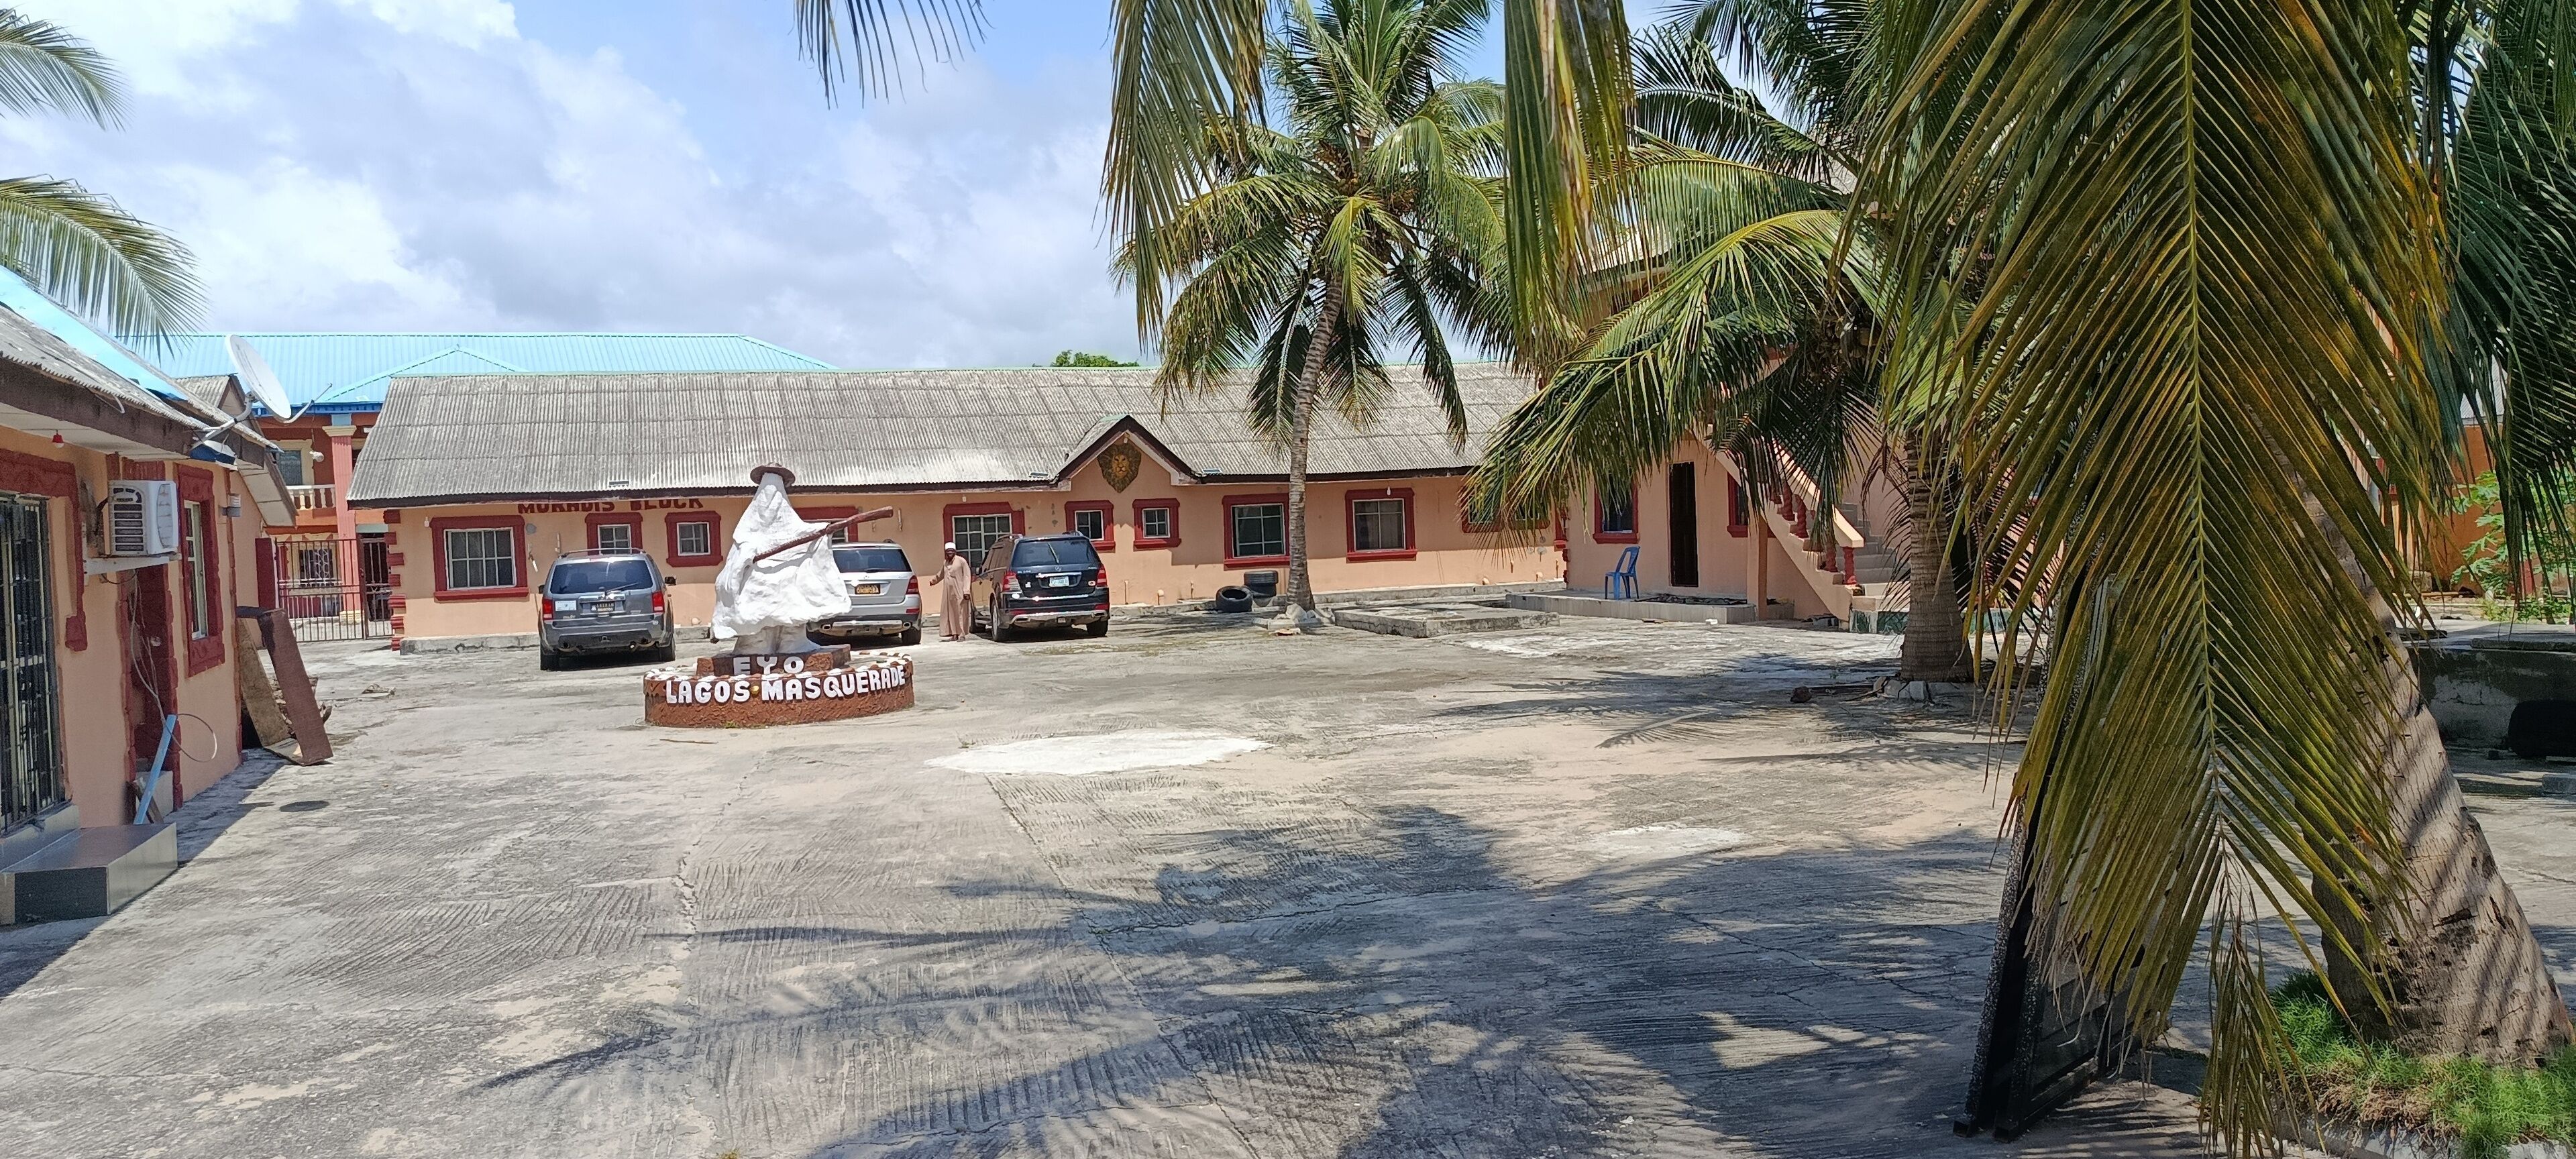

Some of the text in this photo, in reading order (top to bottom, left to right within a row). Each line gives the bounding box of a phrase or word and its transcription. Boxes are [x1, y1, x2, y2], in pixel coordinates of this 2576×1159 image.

[733, 656, 804, 675] EYO
[665, 665, 906, 704] LAGOS MASQUERADE
